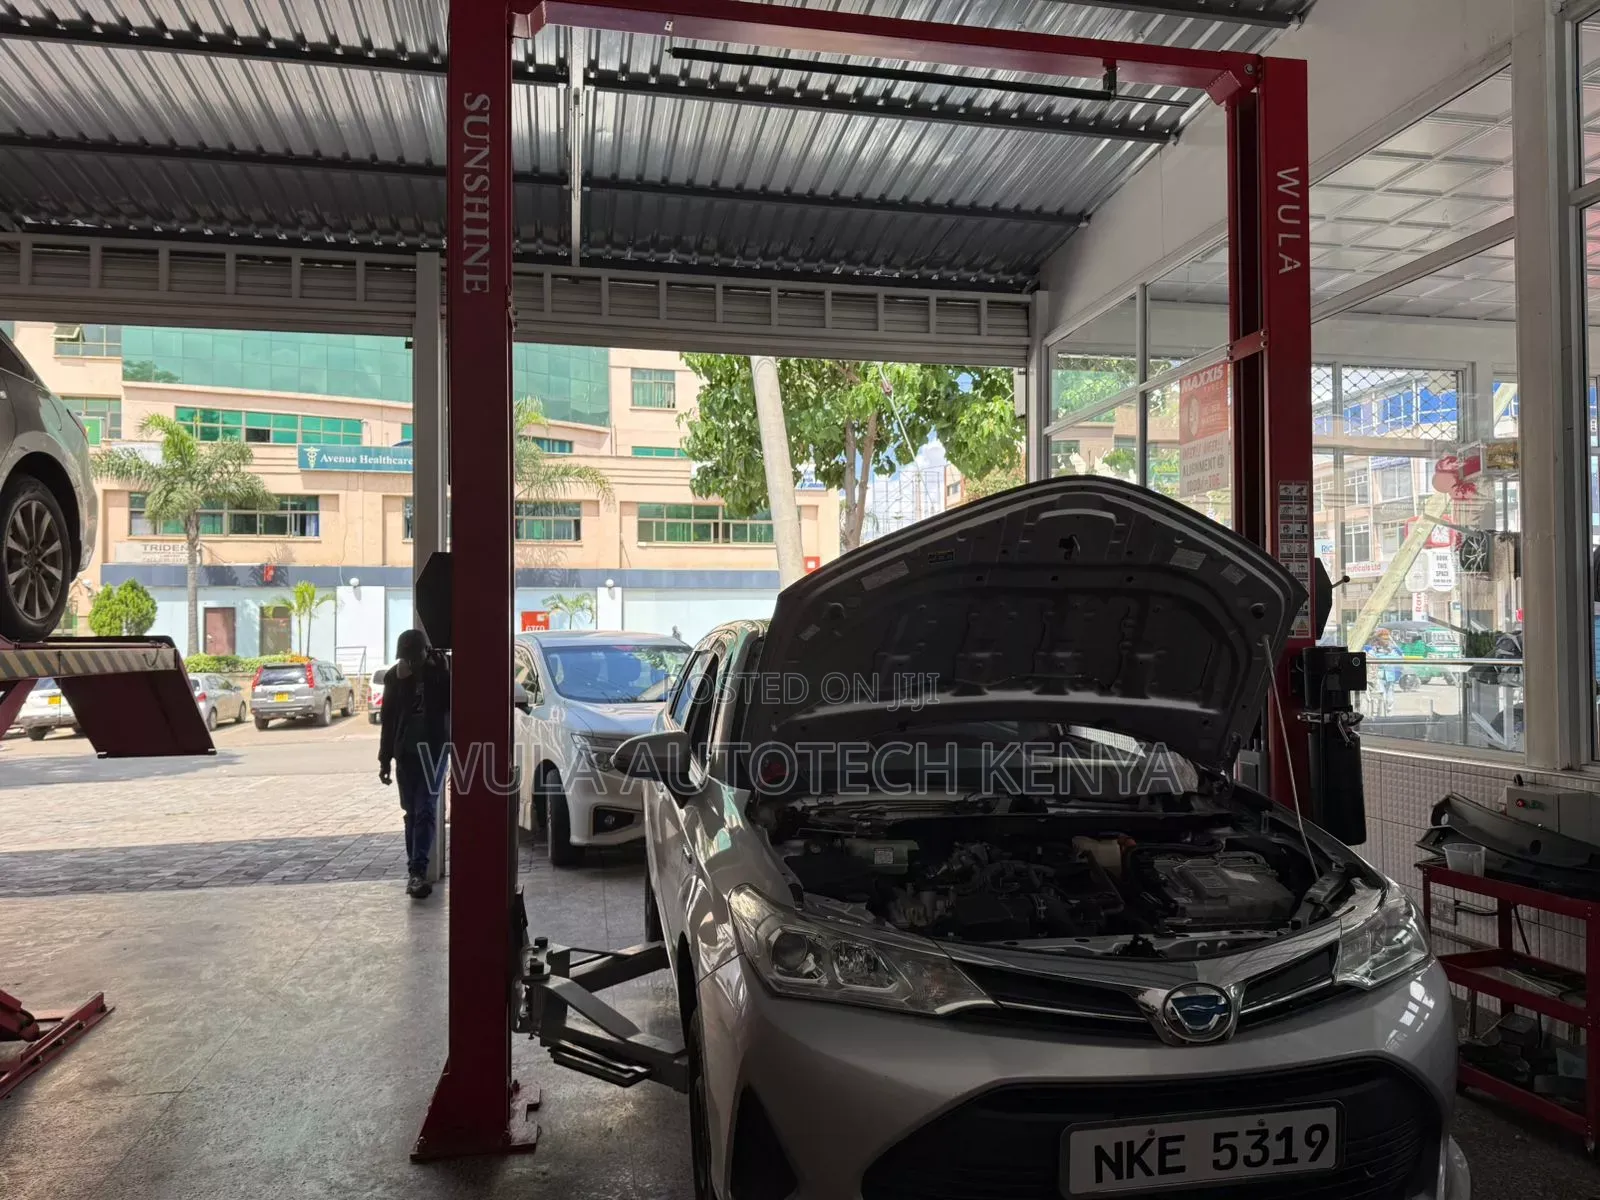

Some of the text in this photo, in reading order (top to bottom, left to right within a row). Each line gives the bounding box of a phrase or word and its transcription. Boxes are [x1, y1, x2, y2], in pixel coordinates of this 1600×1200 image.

[463, 92, 491, 294] SUNSHINE
[1277, 166, 1301, 275] WULA
[1182, 364, 1224, 393] MAXXIS
[320, 453, 414, 466] Avenue Healthcare
[142, 544, 190, 552] TRIDEN
[1094, 1123, 1330, 1184] NKE 5319
